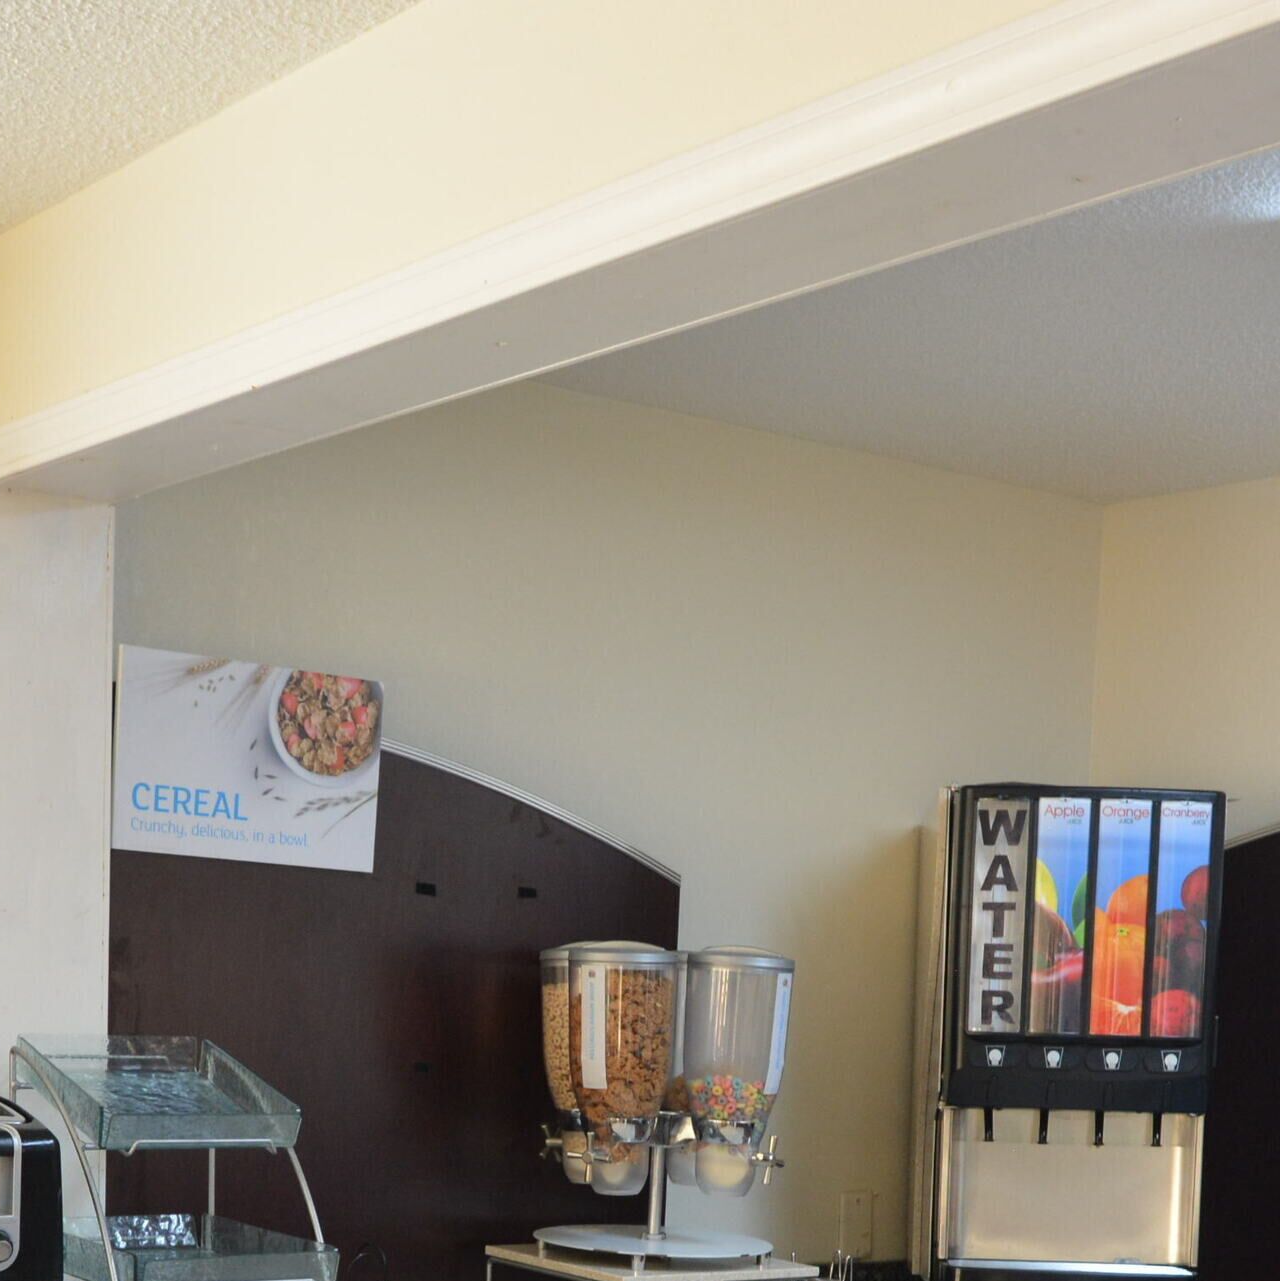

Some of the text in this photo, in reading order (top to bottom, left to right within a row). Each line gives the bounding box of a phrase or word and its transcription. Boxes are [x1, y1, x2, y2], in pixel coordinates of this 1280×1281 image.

[132, 782, 248, 821] CEREAL
[1045, 804, 1210, 820] Apple Orange Cranberry
[130, 816, 188, 839] Crunchy,
[192, 823, 249, 842] delicious,
[253, 830, 264, 842] in
[269, 832, 276, 844] a
[977, 808, 1028, 1026] WATER
